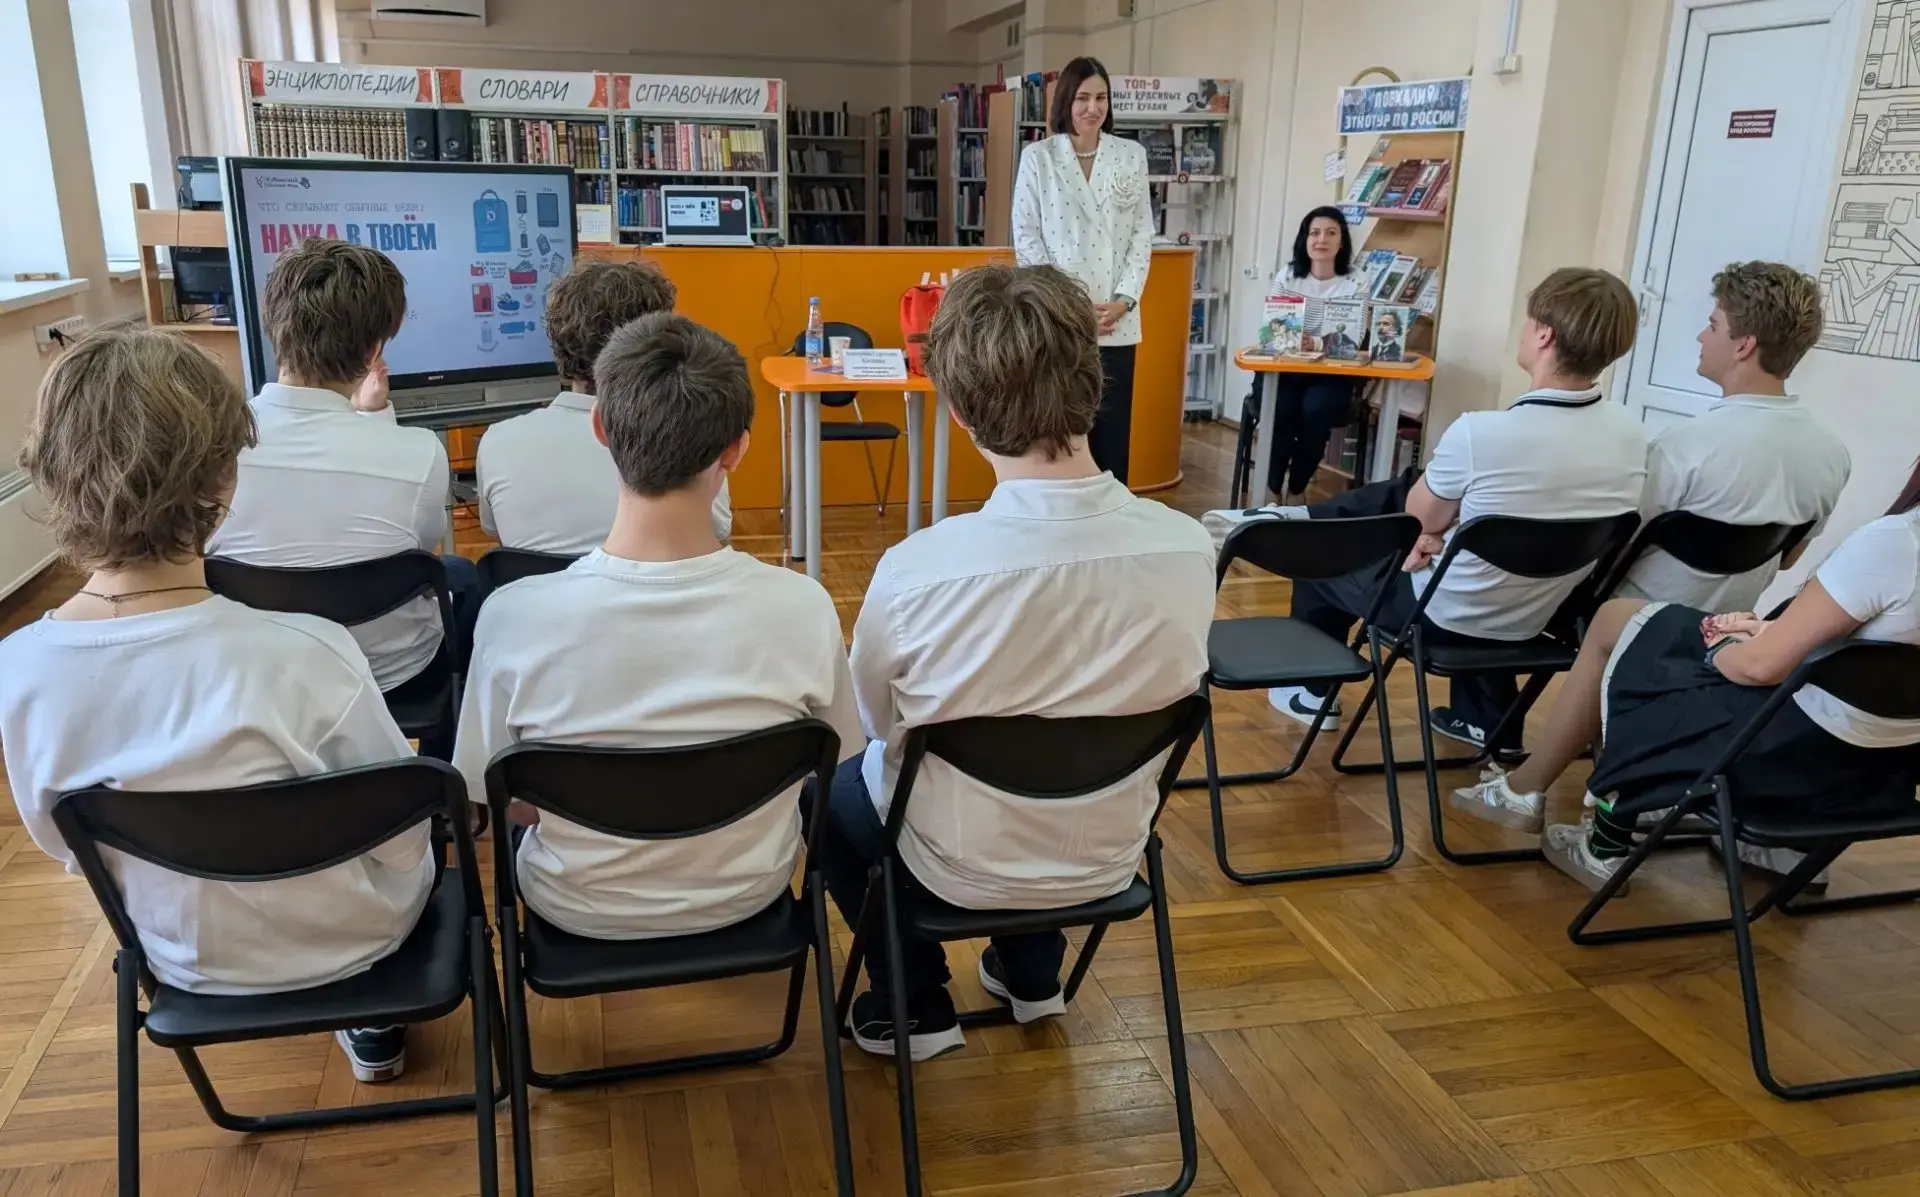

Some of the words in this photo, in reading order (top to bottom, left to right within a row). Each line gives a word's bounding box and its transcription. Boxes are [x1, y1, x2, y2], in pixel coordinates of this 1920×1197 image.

[265, 69, 416, 95] ЭНЦИКЛОПЕДИИ
[479, 78, 570, 102] СЛОВАРИ
[1124, 78, 1160, 90] ТОП-9
[635, 83, 760, 106] СПРАВОЧНИКИ
[1112, 91, 1131, 101] МЫХ
[1135, 90, 1181, 101] КРАСИВЫХ
[1113, 102, 1133, 111] МЕСТ
[1137, 102, 1168, 112] КУБАНИ
[1392, 110, 1409, 127] ПО
[1410, 109, 1456, 127] РОССИИ
[366, 214, 437, 251] ТВОЁМ
